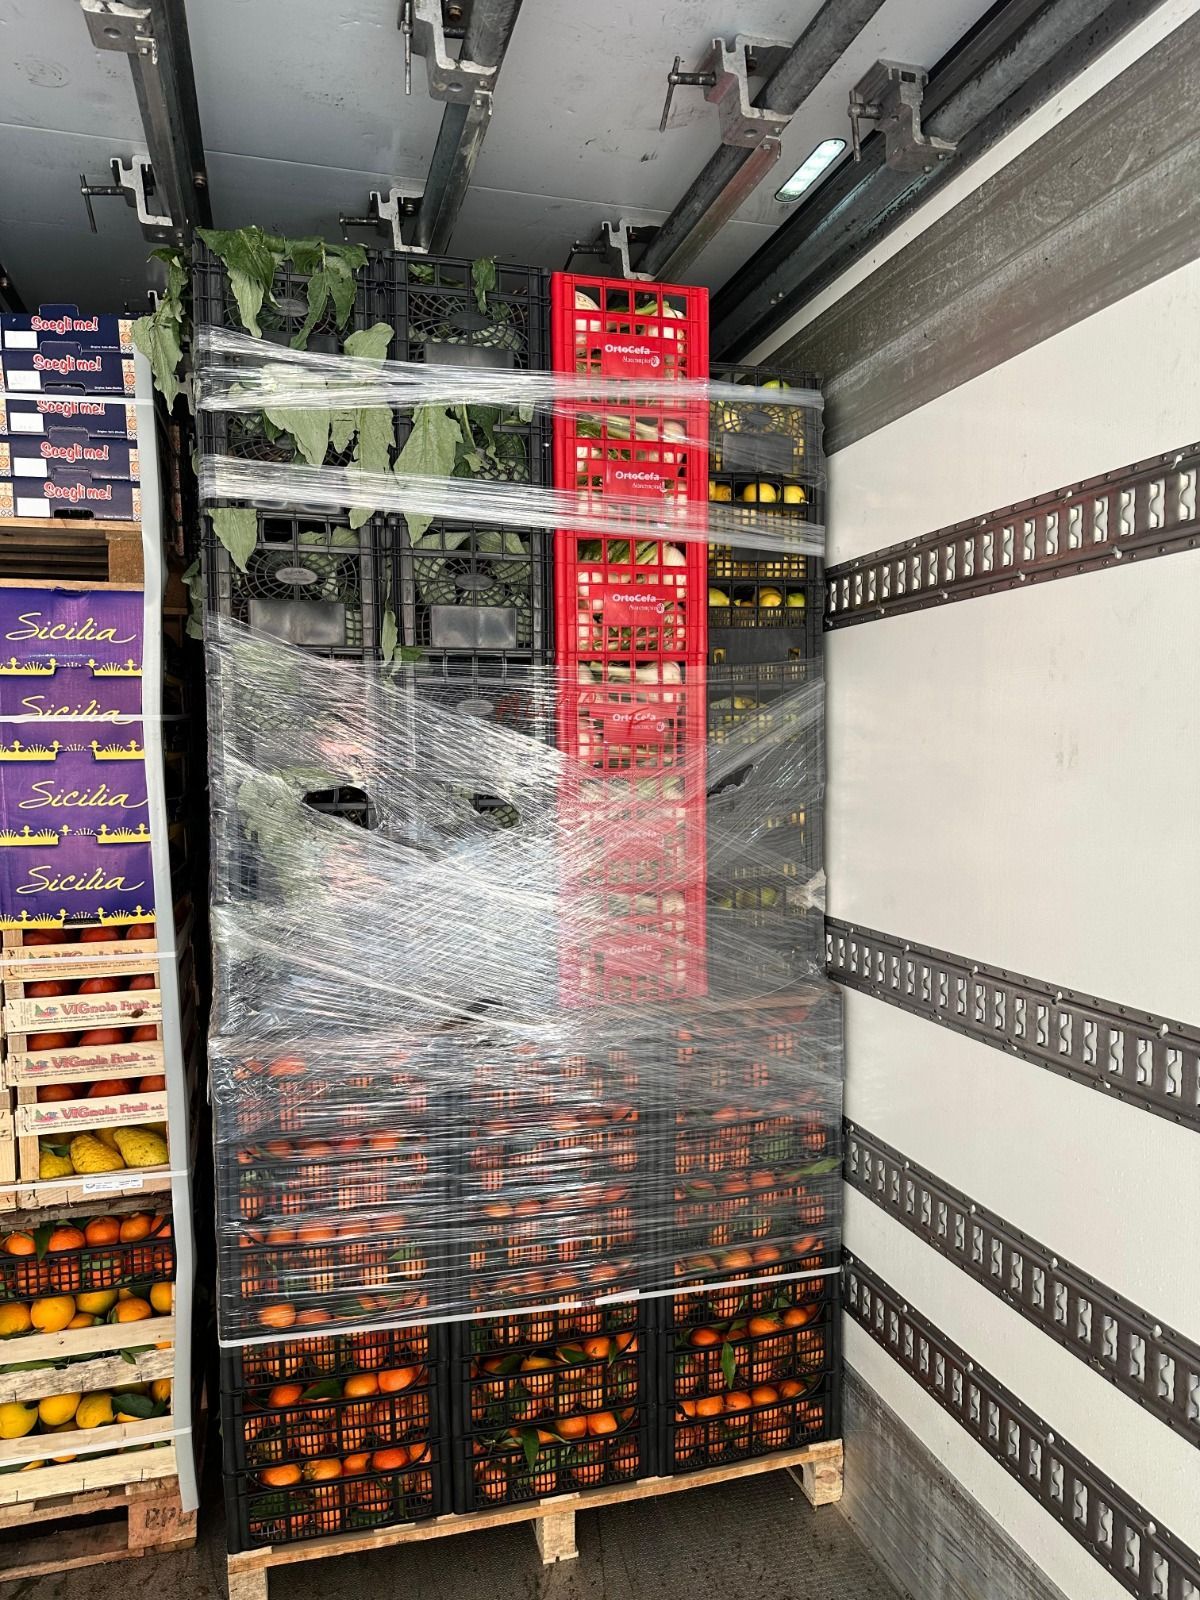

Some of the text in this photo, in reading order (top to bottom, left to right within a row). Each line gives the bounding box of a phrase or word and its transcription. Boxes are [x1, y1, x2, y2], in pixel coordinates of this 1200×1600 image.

[31, 316, 99, 334] Scegli me!
[605, 344, 650, 355] OrtoCefa
[33, 354, 102, 374] Scegli me!
[40, 442, 109, 463] Scegli me!
[615, 471, 660, 481] OrtoCefa
[43, 482, 112, 502] Scegli me!
[612, 593, 657, 602] OrtoCefa
[5, 612, 137, 644] Sicilia
[14, 695, 133, 725] Sicilia
[19, 780, 148, 809] Sicilia
[16, 865, 144, 894] Sicilia
[110, 1052, 140, 1063] Fruit
[119, 1102, 149, 1113] Fruit
